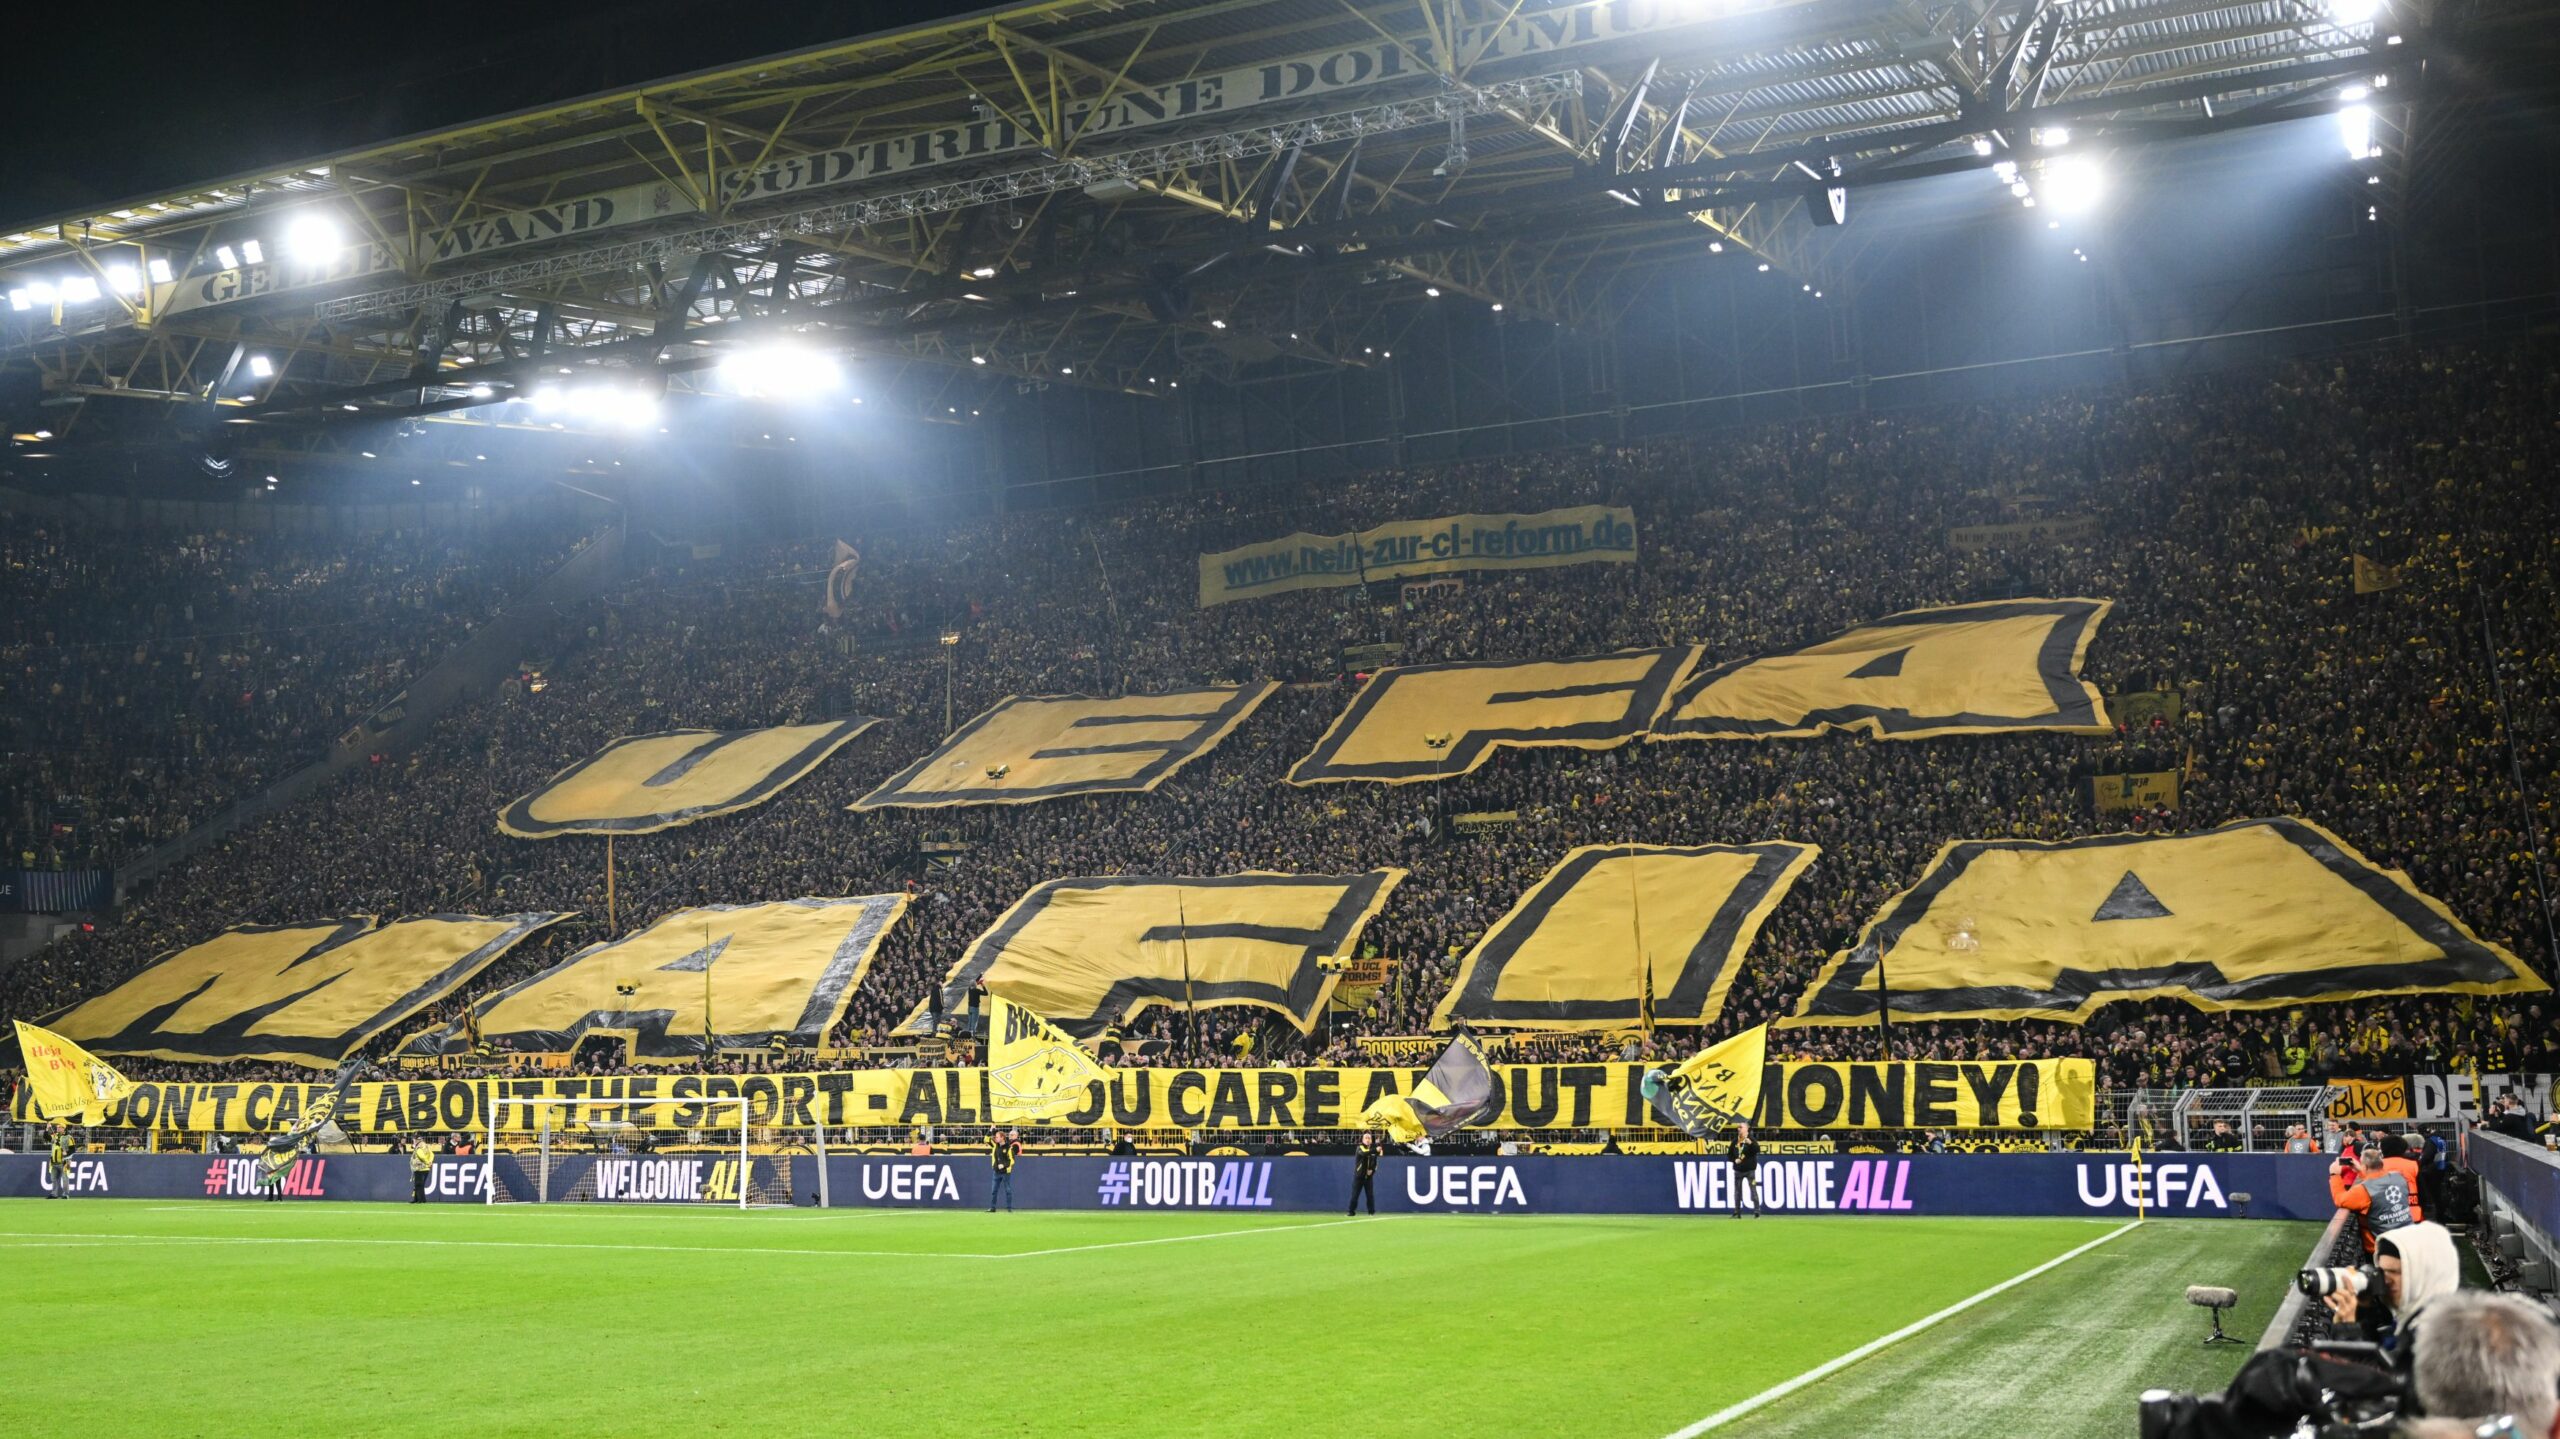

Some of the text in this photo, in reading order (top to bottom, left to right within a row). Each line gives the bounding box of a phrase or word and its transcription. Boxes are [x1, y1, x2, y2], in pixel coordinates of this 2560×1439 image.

[429, 198, 614, 258] WAND
[1224, 514, 1634, 588] www.nein-zur-cl-reform.de
[1362, 961, 1382, 971] UCL
[374, 1080, 544, 1132] ABOUT
[556, 1077, 658, 1128] THE
[672, 1073, 854, 1128] SPORT
[1168, 1070, 1340, 1129] CARE
[596, 1160, 703, 1199] WELCOME
[862, 1164, 960, 1200] UEFA
[1098, 1161, 1273, 1206] #FOOTBALL
[1407, 1165, 1528, 1205] UEFA
[1839, 1160, 1913, 1210] ALL
[2076, 1164, 2228, 1208] UEFA
